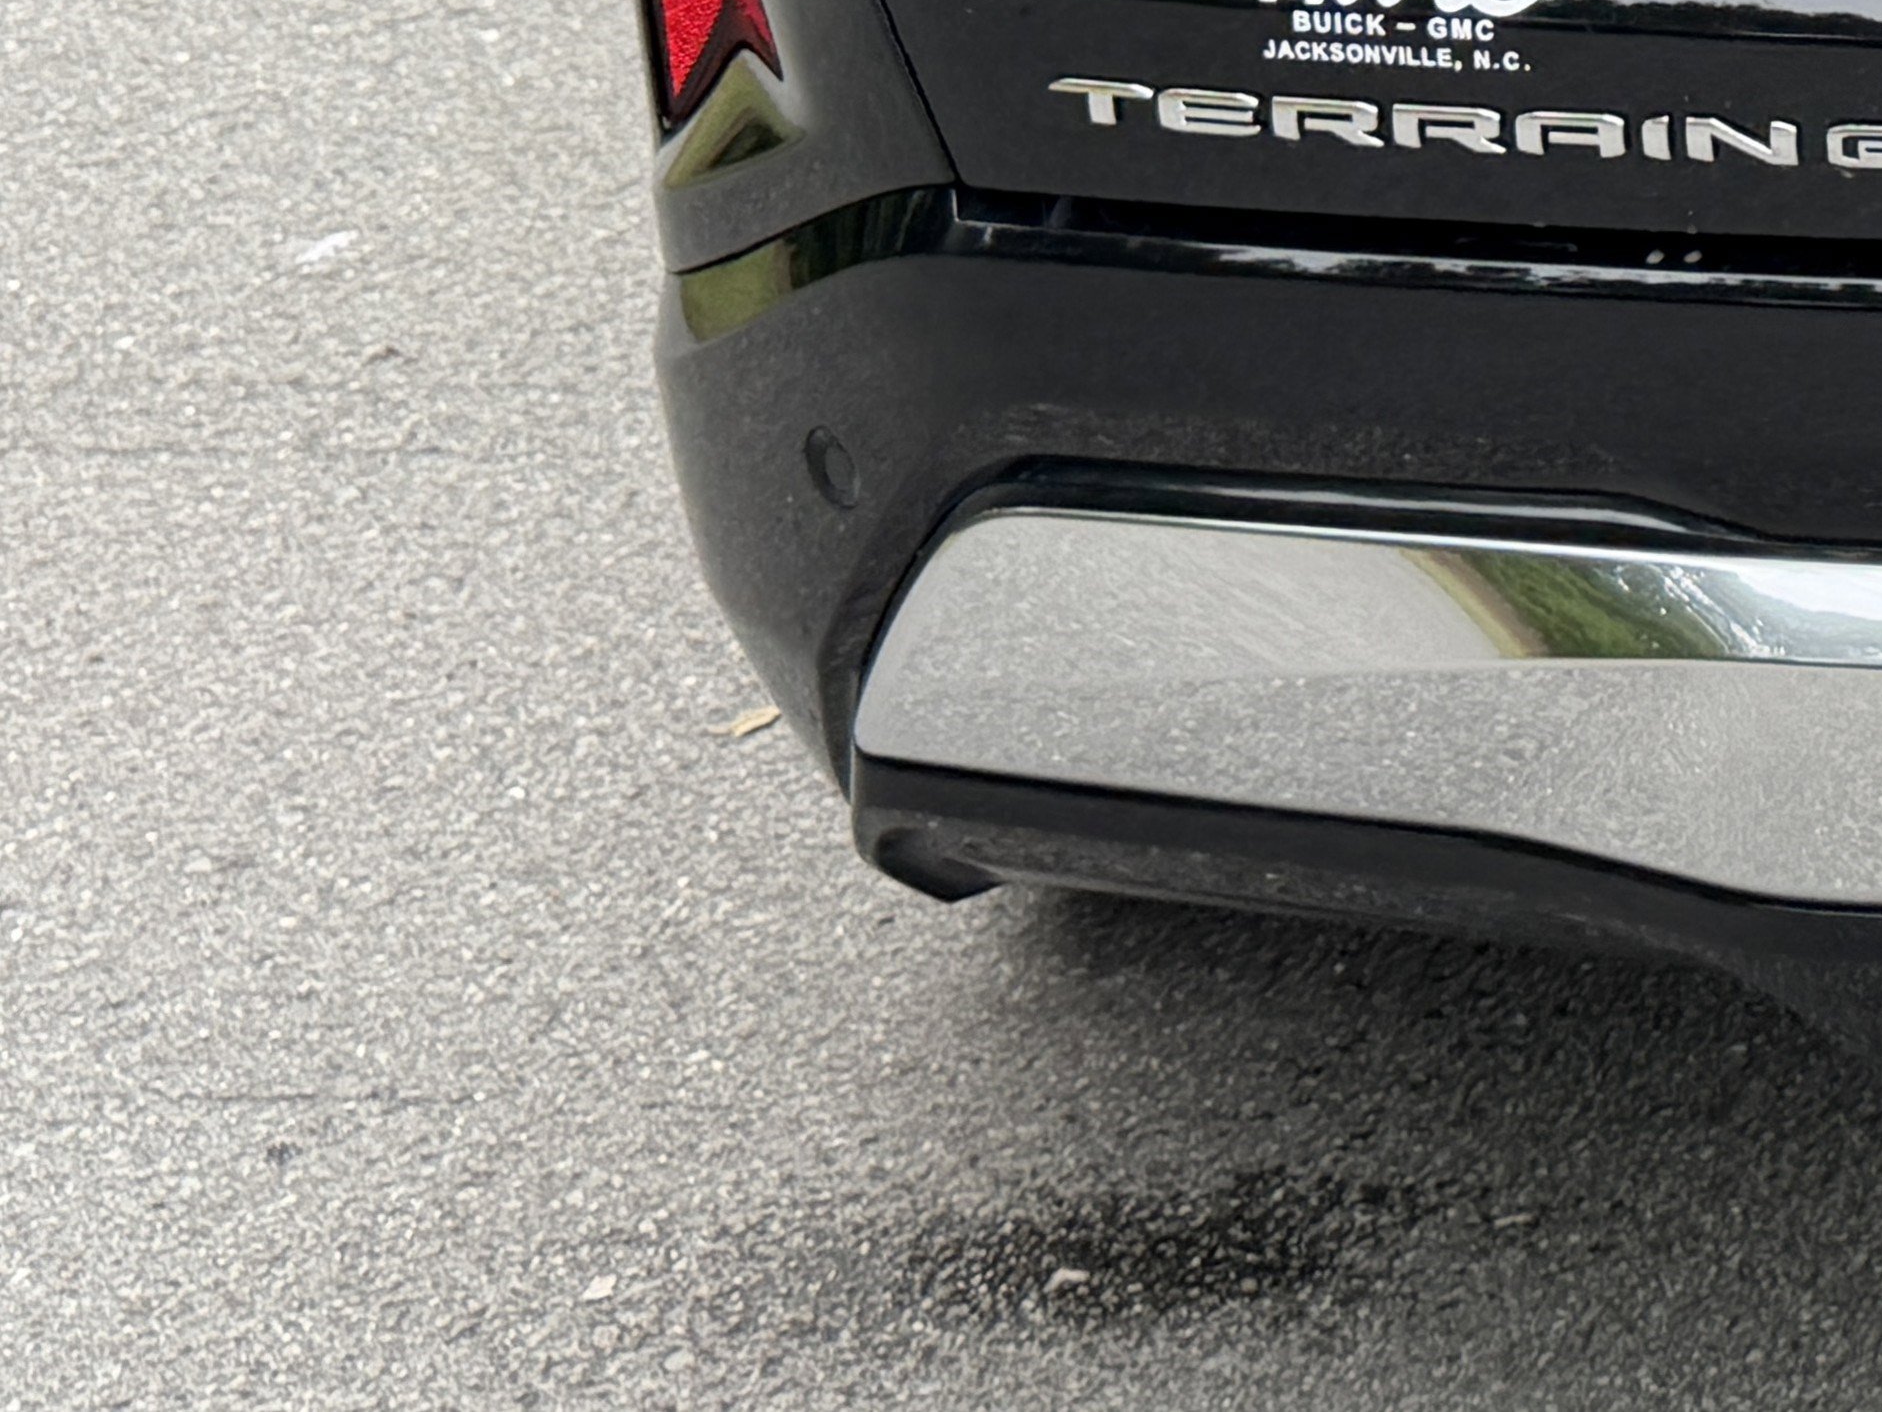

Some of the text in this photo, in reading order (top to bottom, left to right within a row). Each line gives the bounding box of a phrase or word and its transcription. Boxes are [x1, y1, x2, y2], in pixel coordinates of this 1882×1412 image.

[1292, 10, 1386, 36] BUICK
[1427, 16, 1495, 41] GMC
[1262, 39, 1531, 72] JACKSONVILLE, N.C.
[1048, 77, 1798, 166] TERRAIN
